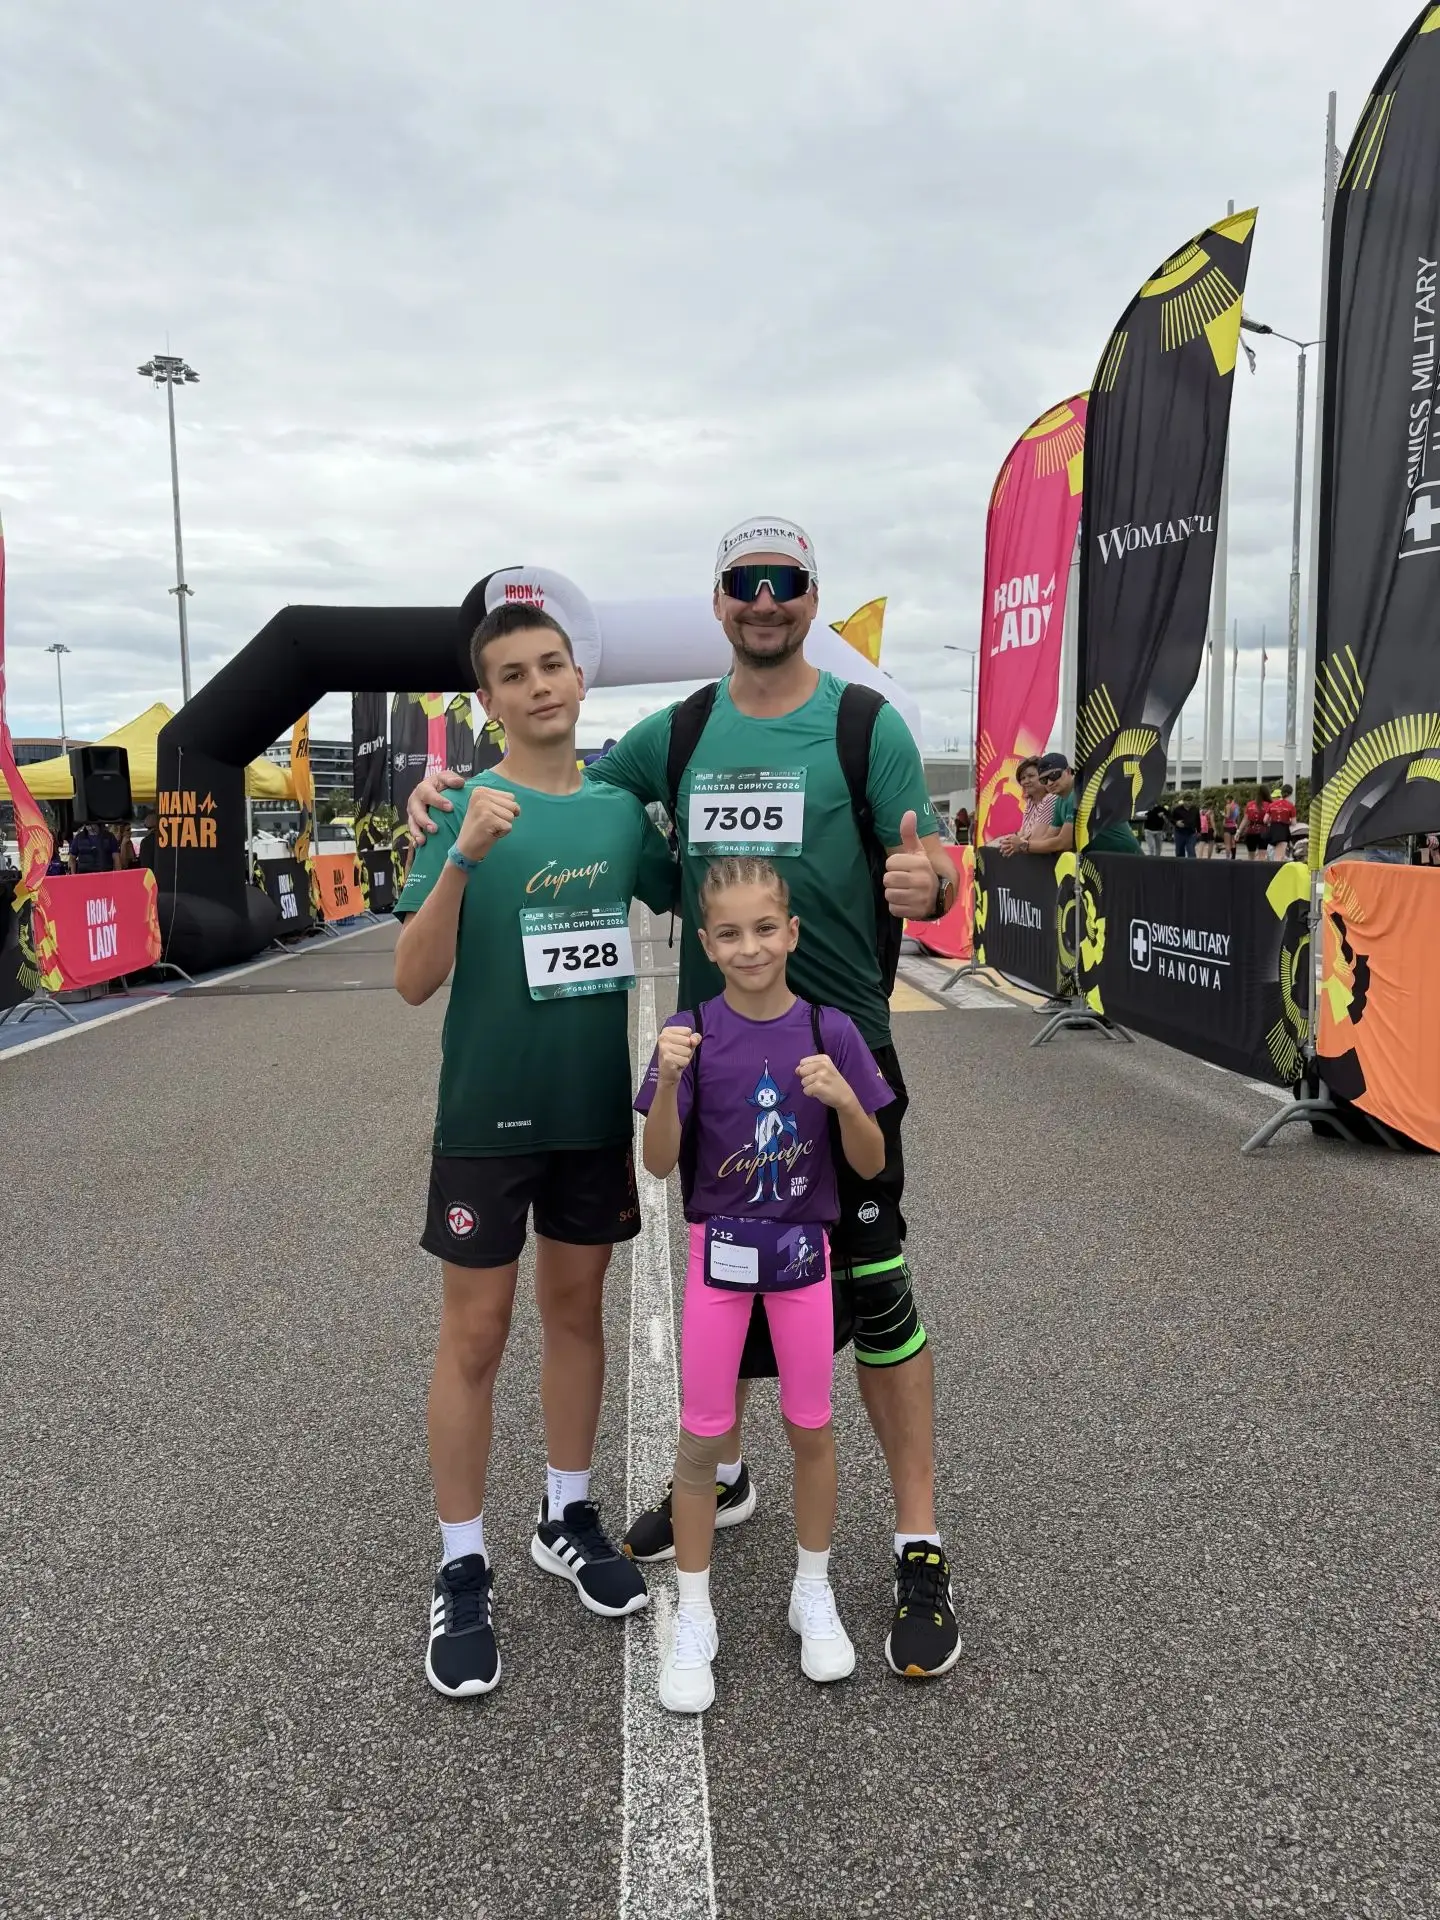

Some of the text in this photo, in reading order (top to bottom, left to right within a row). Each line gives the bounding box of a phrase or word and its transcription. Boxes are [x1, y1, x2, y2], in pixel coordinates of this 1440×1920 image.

[1412, 256, 1438, 391] MILITARY
[505, 584, 532, 599] IRON
[737, 782, 774, 790] СИРИУС
[776, 782, 800, 790] 2026
[159, 791, 196, 815] MAN
[703, 806, 783, 831] 7305
[158, 816, 217, 848] STAR
[525, 859, 609, 899] Сириус
[86, 897, 108, 926] IRON
[525, 918, 625, 933] MANSTAR СИРИУС 2026
[88, 923, 118, 962] LADY
[1151, 922, 1231, 956] SWISS MILITARY
[542, 942, 619, 973] 7328
[1158, 956, 1221, 991] HANOWA
[717, 1139, 814, 1185] Сириус
[711, 1227, 733, 1242] 7-12
